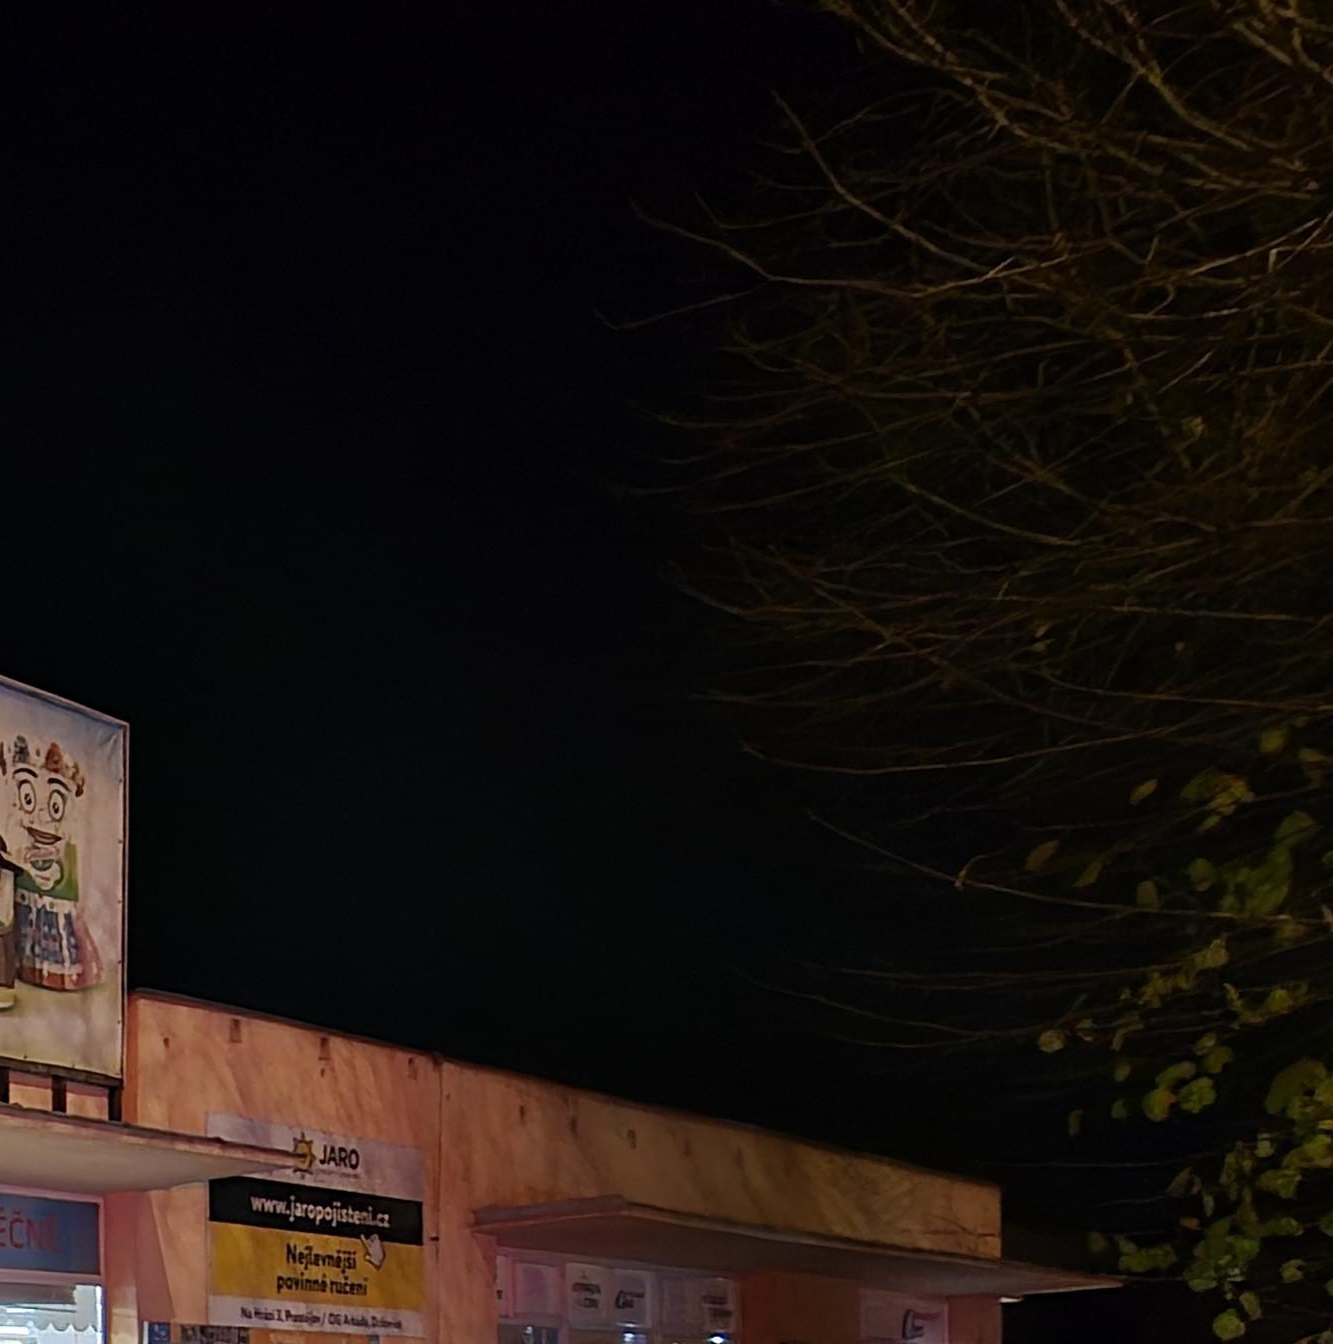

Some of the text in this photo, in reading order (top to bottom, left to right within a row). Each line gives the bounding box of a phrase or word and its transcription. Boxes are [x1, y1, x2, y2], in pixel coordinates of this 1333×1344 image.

[319, 1144, 360, 1170] JARO
[250, 1194, 390, 1228] www.jaropojisteni.cz
[276, 1271, 368, 1297] povinné ručení
